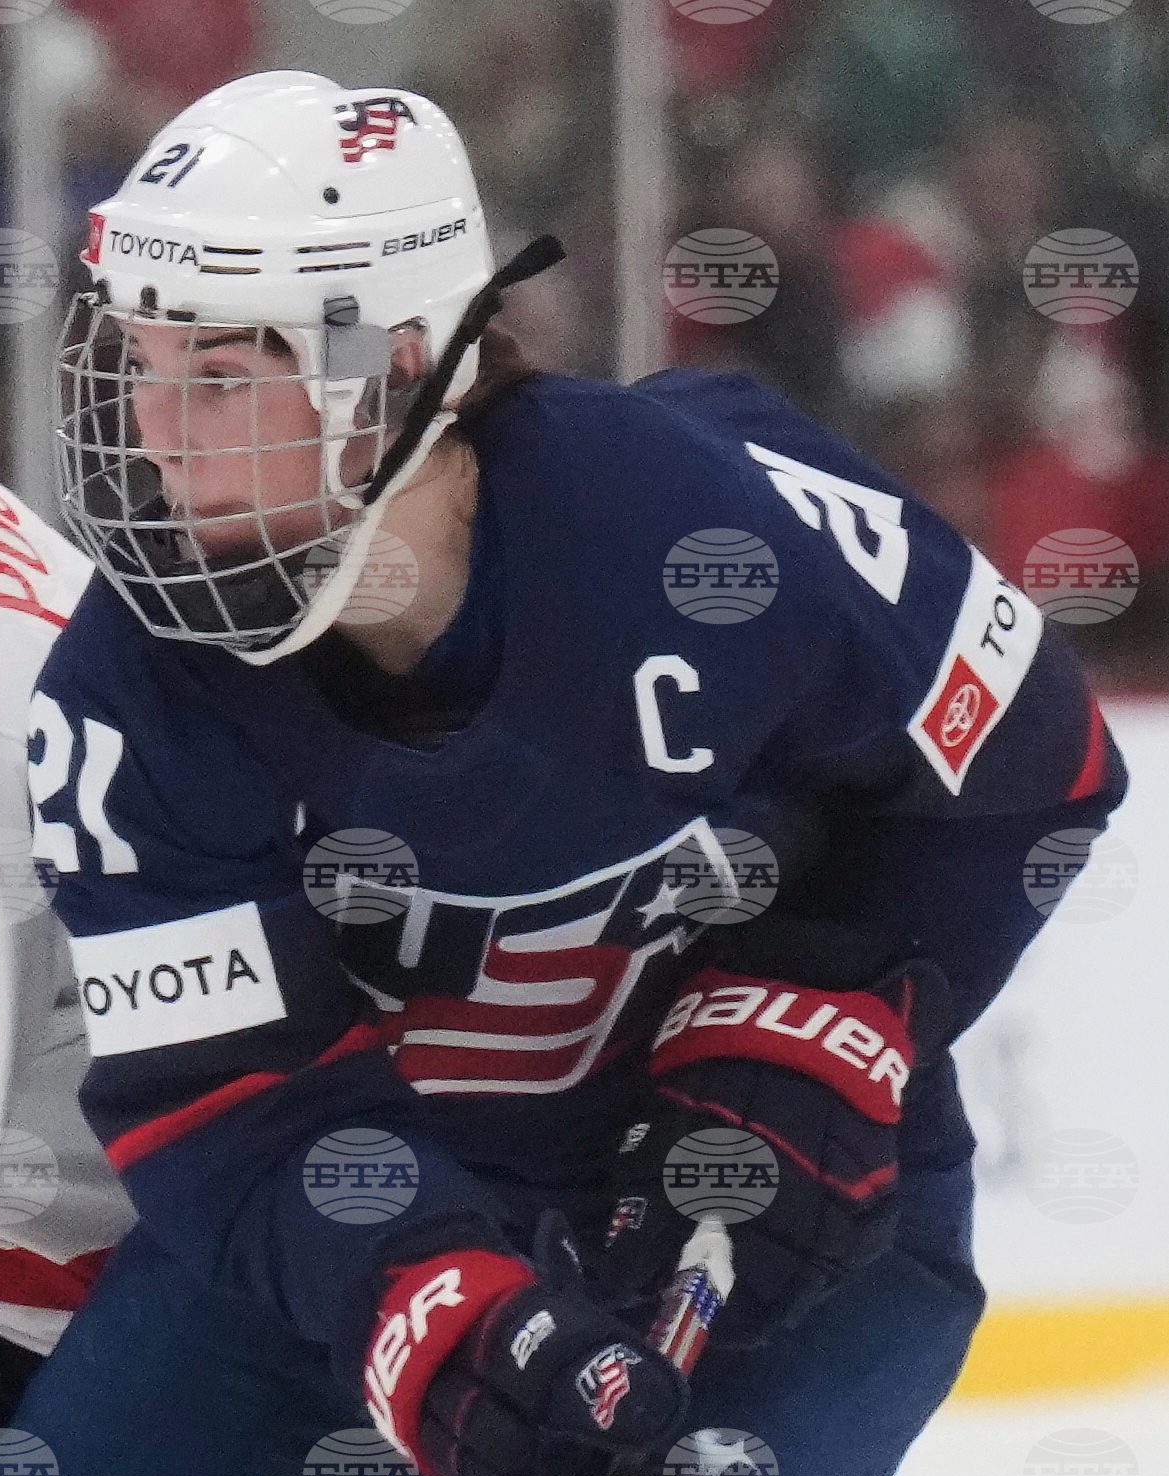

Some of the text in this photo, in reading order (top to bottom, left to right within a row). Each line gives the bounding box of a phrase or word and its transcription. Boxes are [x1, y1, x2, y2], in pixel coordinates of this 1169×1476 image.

[139, 142, 205, 188] 21
[109, 230, 200, 267] TOYOTA
[744, 441, 909, 605] 21
[633, 654, 714, 774] C
[83, 948, 261, 1016] OYOTA
[652, 985, 910, 1106] BAUER
